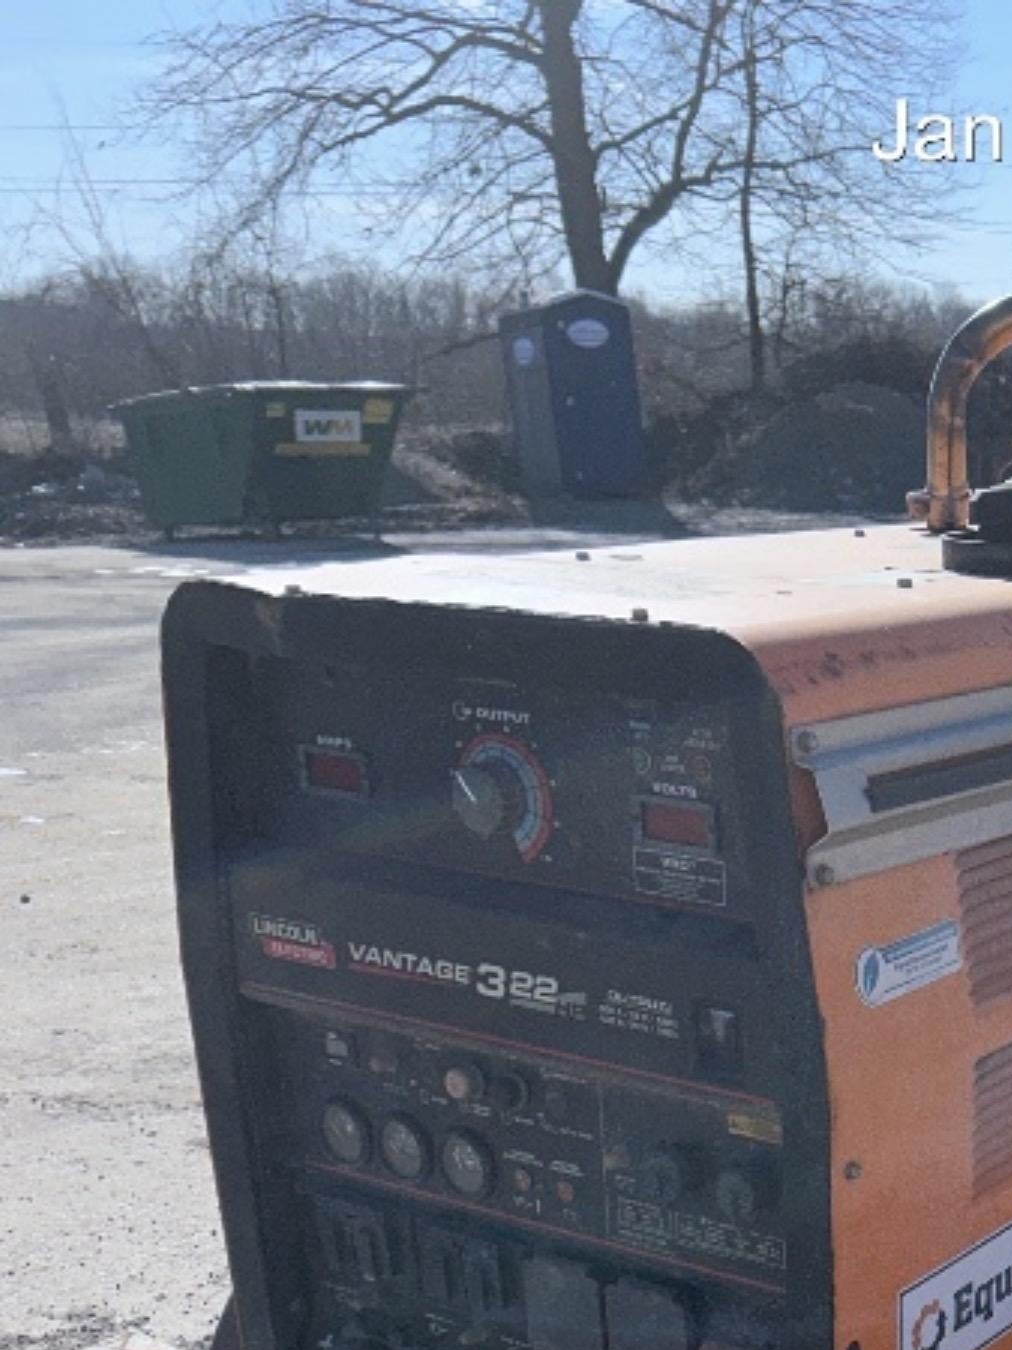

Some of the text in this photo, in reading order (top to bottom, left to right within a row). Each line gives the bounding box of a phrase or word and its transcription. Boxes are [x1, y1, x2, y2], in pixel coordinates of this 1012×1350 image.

[303, 418, 354, 437] WM
[475, 706, 531, 724] OUTPUT
[252, 916, 319, 946] LINCOLN
[347, 942, 560, 1002] VANTAGE 322
